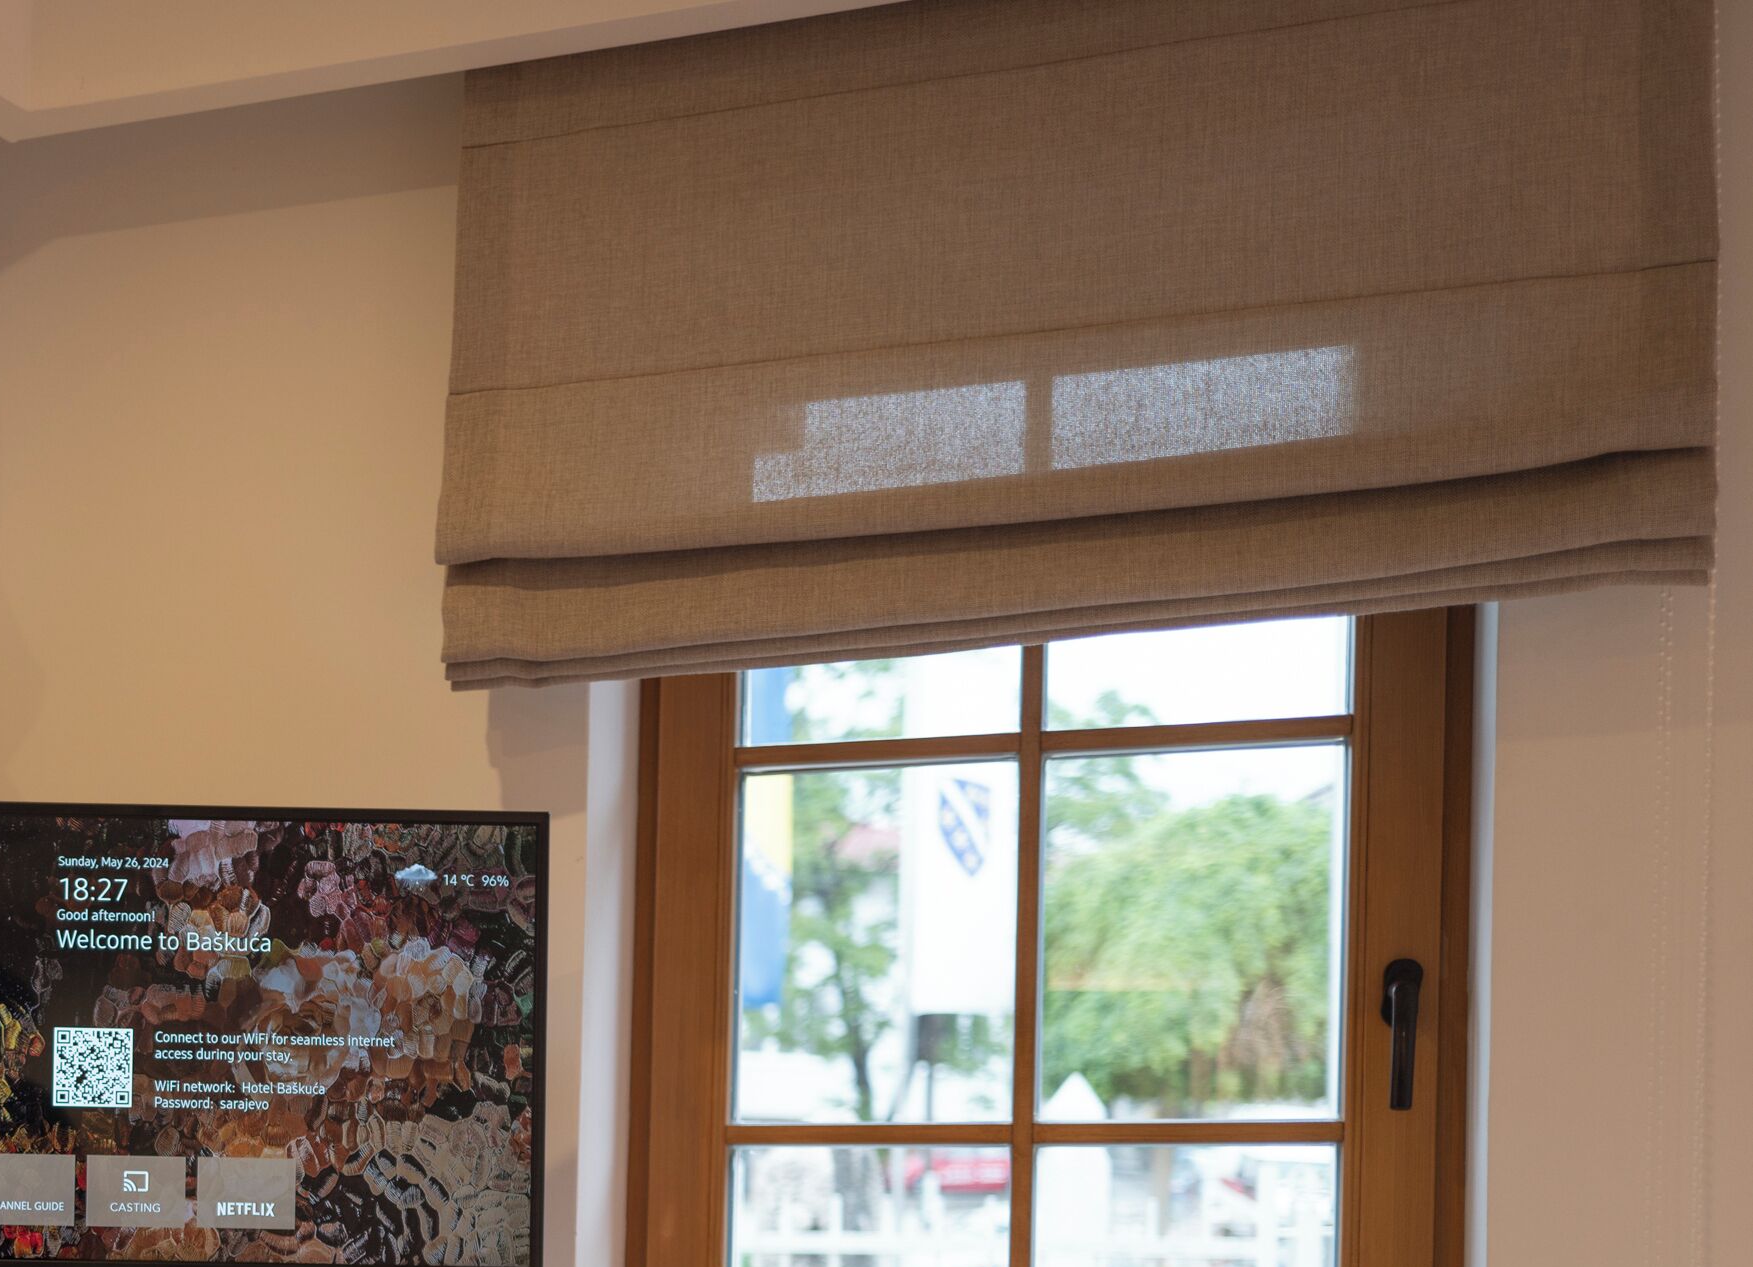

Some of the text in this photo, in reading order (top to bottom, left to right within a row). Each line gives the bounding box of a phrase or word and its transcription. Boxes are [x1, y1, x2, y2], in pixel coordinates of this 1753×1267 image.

[58, 856, 169, 869] Sunday, May 26, 2024
[443, 874, 457, 886] 14
[481, 874, 509, 887] 96%
[59, 878, 128, 901] 18:27
[57, 909, 155, 922] Good afternoon!
[57, 929, 271, 952] Welcome to Baškuća
[155, 1031, 395, 1047] Connect to our WiFi for seamless internet
[155, 1048, 292, 1063] access during your stay.
[155, 1080, 326, 1094] WiFi network: Hotel Baškuća
[154, 1097, 269, 1113] Password: sarajevo
[34, 1201, 65, 1211] GUIDE
[110, 1202, 161, 1213] CASTING
[216, 1202, 275, 1217] NETFLIX
